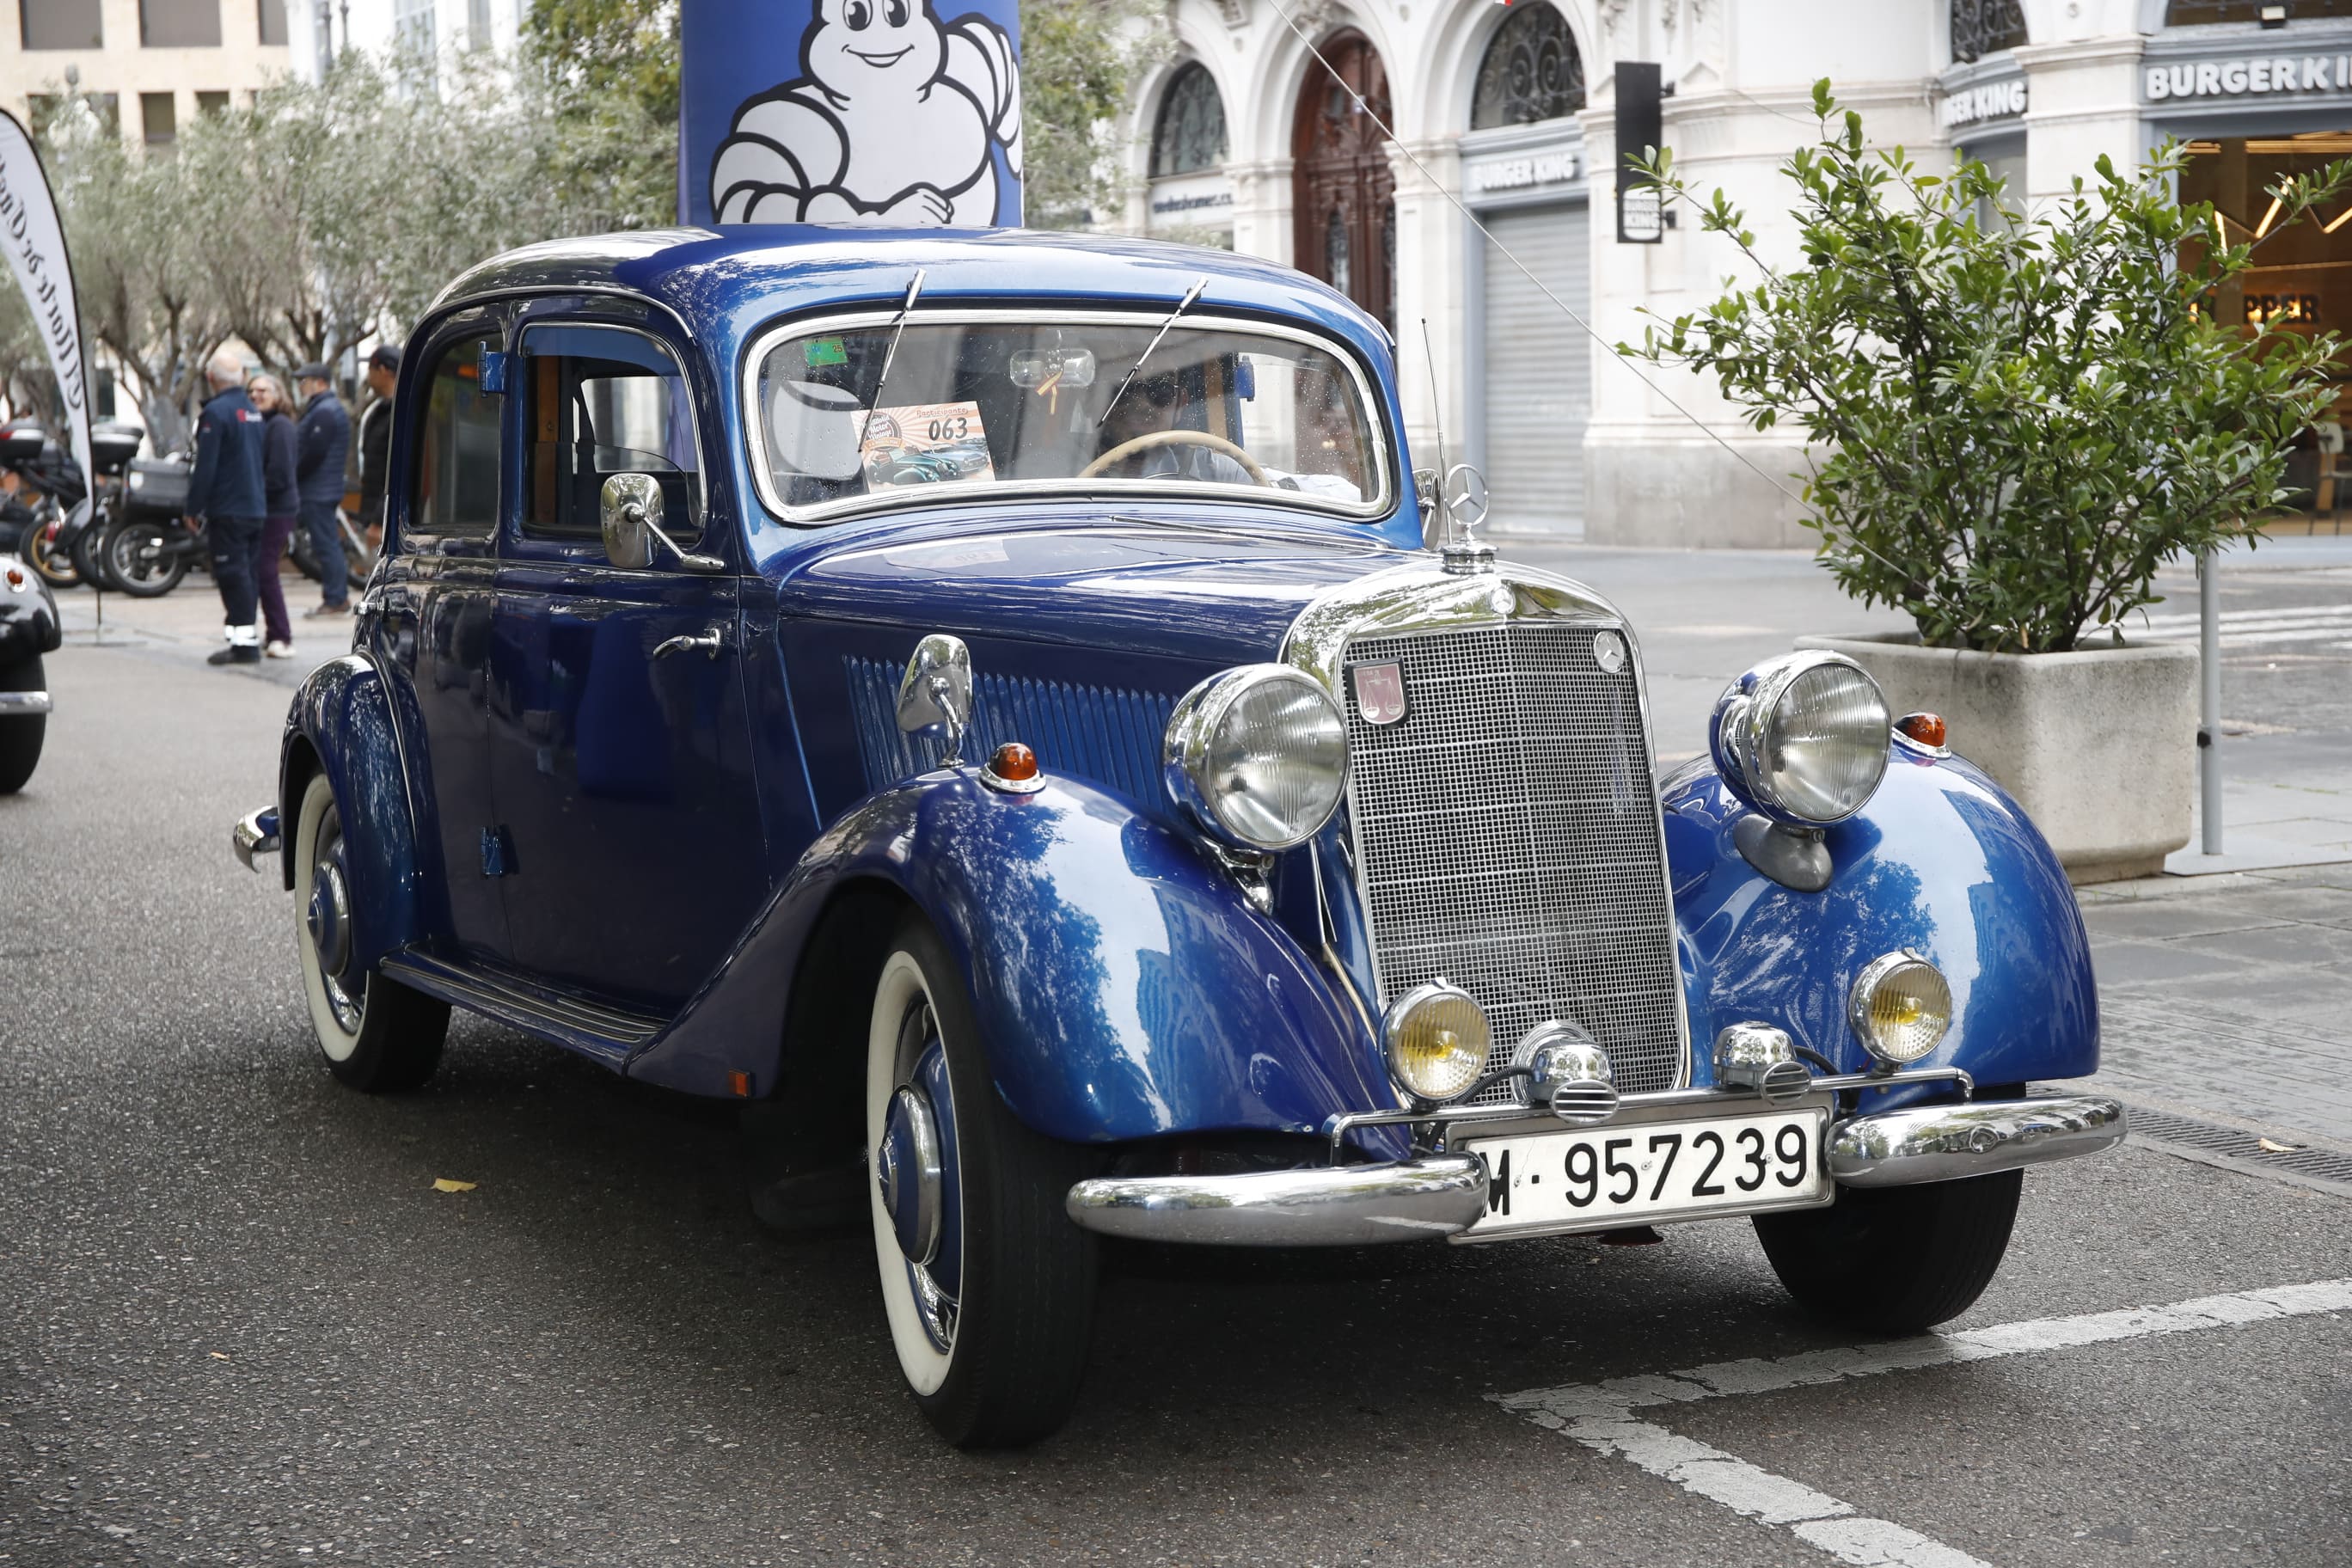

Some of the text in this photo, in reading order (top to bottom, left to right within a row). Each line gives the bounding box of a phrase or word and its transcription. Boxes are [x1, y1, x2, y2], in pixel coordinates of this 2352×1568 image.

[2147, 55, 2352, 100] BURGER KI
[1974, 81, 2026, 119] KING
[1469, 152, 1575, 192] BURGER KING
[1623, 211, 1660, 229] KING
[868, 421, 890, 433] Motor
[928, 416, 968, 441] 063
[1565, 1124, 1807, 1207] 957239
